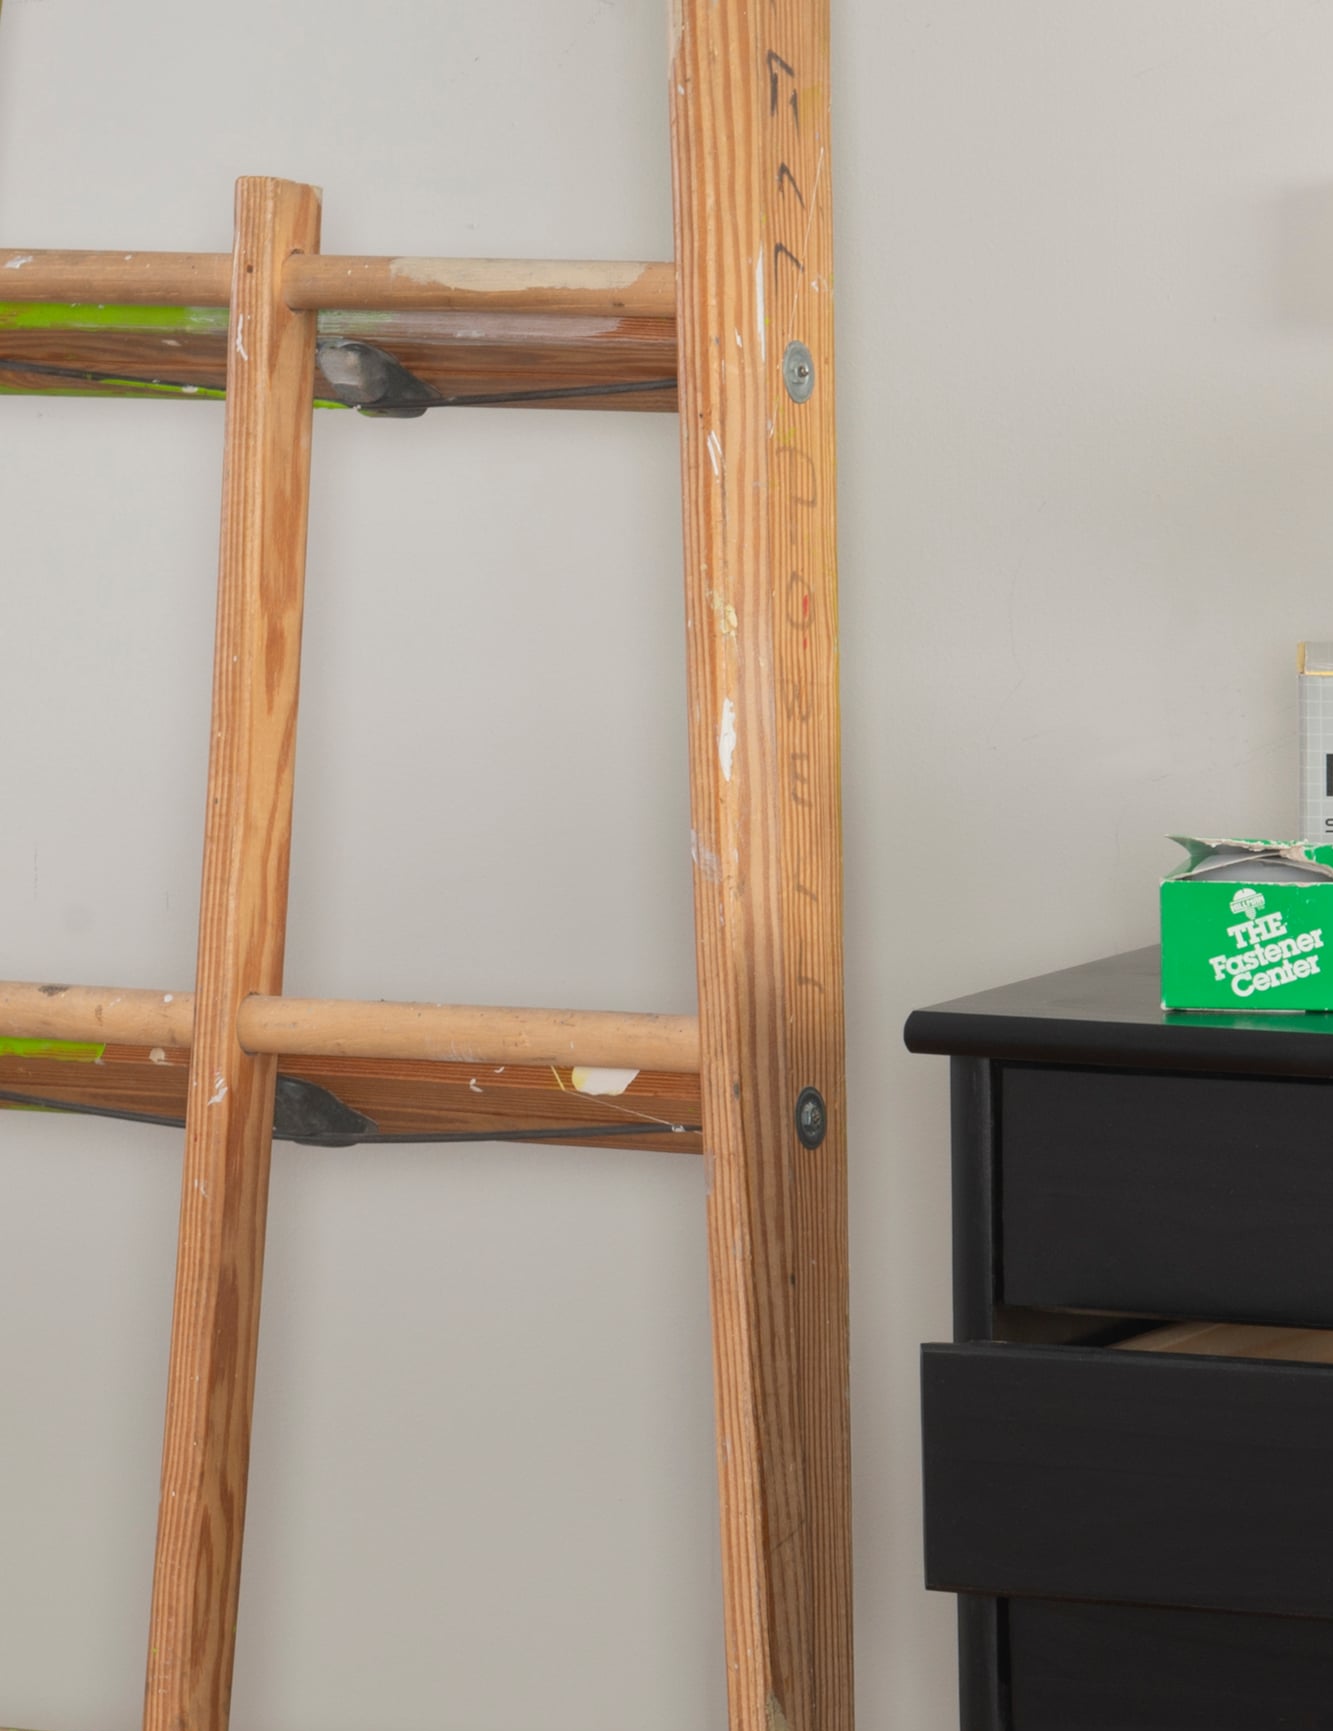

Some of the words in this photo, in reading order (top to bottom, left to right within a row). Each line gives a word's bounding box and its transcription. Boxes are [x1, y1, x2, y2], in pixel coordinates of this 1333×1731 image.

[1227, 911, 1288, 949] THE
[1208, 928, 1324, 982] Fastener
[1231, 954, 1321, 997] Center
